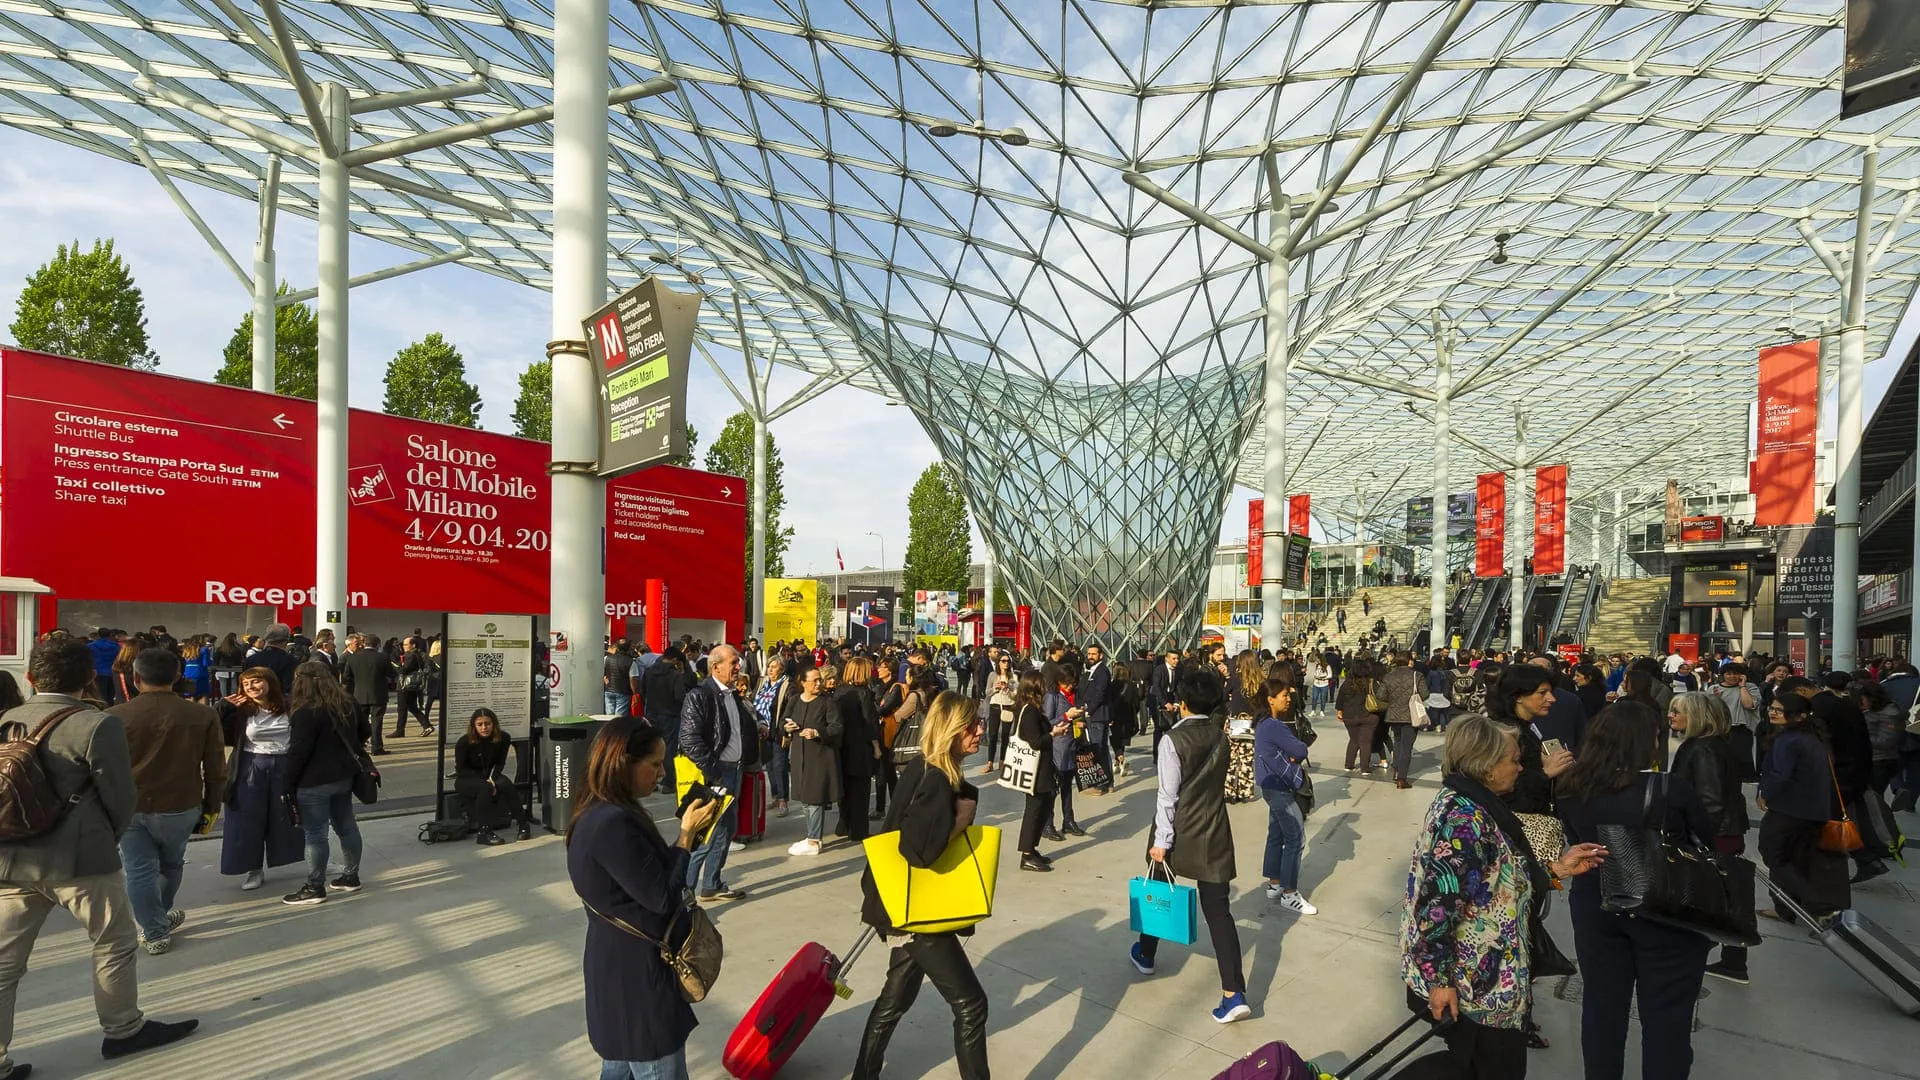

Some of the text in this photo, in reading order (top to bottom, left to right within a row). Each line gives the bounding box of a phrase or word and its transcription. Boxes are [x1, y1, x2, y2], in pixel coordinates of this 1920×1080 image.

[623, 312, 652, 334] Underground
[601, 318, 623, 360] M
[626, 331, 642, 344] Station
[628, 331, 665, 358] RHO FIERA
[611, 367, 655, 395] Ponte dei Mari
[610, 396, 639, 415] Reception
[54, 411, 179, 437] Circolare esterna
[54, 424, 134, 444] Shuttle Bus
[54, 443, 119, 460] Ingresso
[122, 451, 177, 467] Stampa
[180, 458, 216, 472] Porta
[219, 463, 244, 475] Sud
[407, 434, 497, 470] Salone
[54, 456, 90, 470] Press
[93, 463, 154, 477] entrance
[158, 468, 189, 481] Gate
[192, 472, 228, 485] South
[54, 475, 166, 496] Taxi collettivo
[406, 462, 537, 500] del Mobile
[55, 489, 127, 506] Share taxi
[404, 488, 498, 521] Milano
[614, 491, 675, 506] Ingresso visitatori
[614, 509, 634, 517] Ticket
[620, 501, 647, 512] Stampa
[661, 506, 689, 516] biglietto
[404, 517, 551, 552] 4/9.04.20
[614, 518, 704, 535] and accredited Press entrance
[614, 531, 645, 541] Red Card
[404, 544, 425, 552] Orario
[433, 547, 460, 555] apertura:
[404, 551, 430, 560] Opening
[1780, 556, 1833, 565] Ingress
[1780, 564, 1833, 574] Riservat
[205, 580, 368, 611] Receptn
[1801, 583, 1833, 592] Tesser
[562, 757, 570, 799] GLASS/METAL
[1001, 764, 1033, 789] DIE
[1079, 772, 1097, 782] 2017
